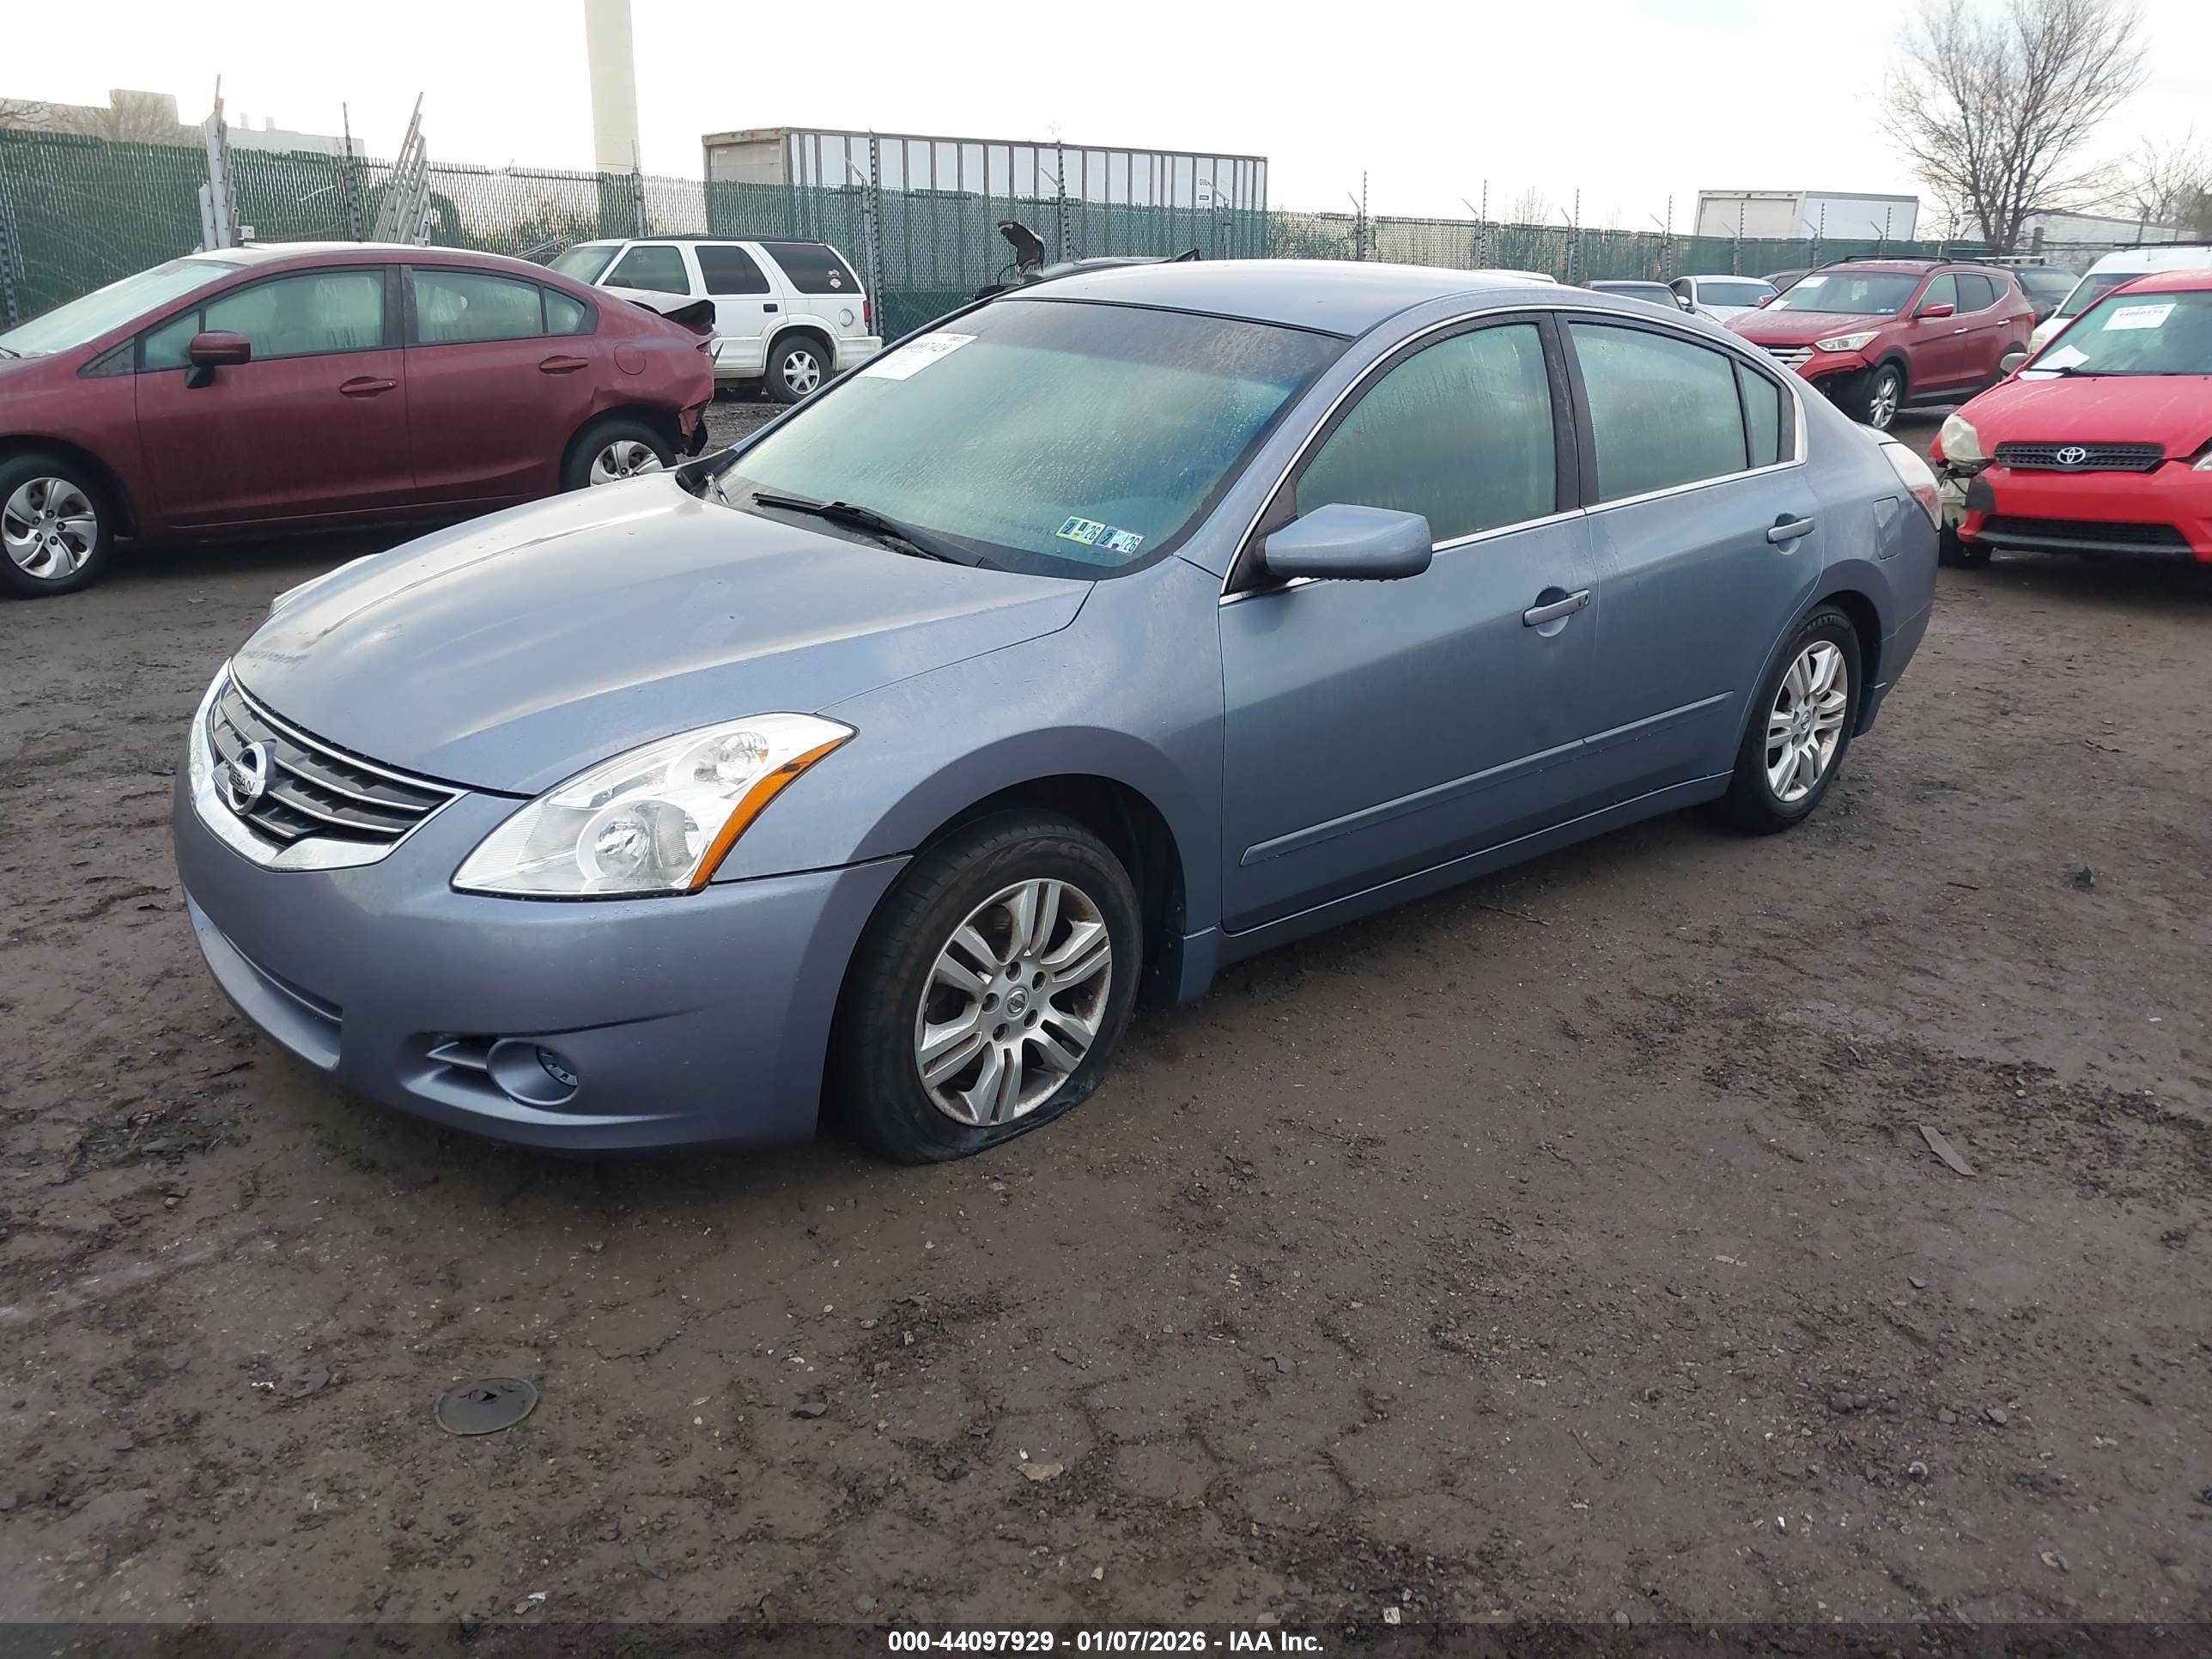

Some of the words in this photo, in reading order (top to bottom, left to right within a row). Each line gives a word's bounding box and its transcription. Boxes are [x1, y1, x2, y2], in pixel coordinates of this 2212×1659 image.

[1063, 522, 1075, 535] 2
[1084, 526, 1101, 540] 26
[1101, 532, 1113, 545] 2
[1124, 536, 1140, 552] 26
[232, 770, 256, 793] SSAN
